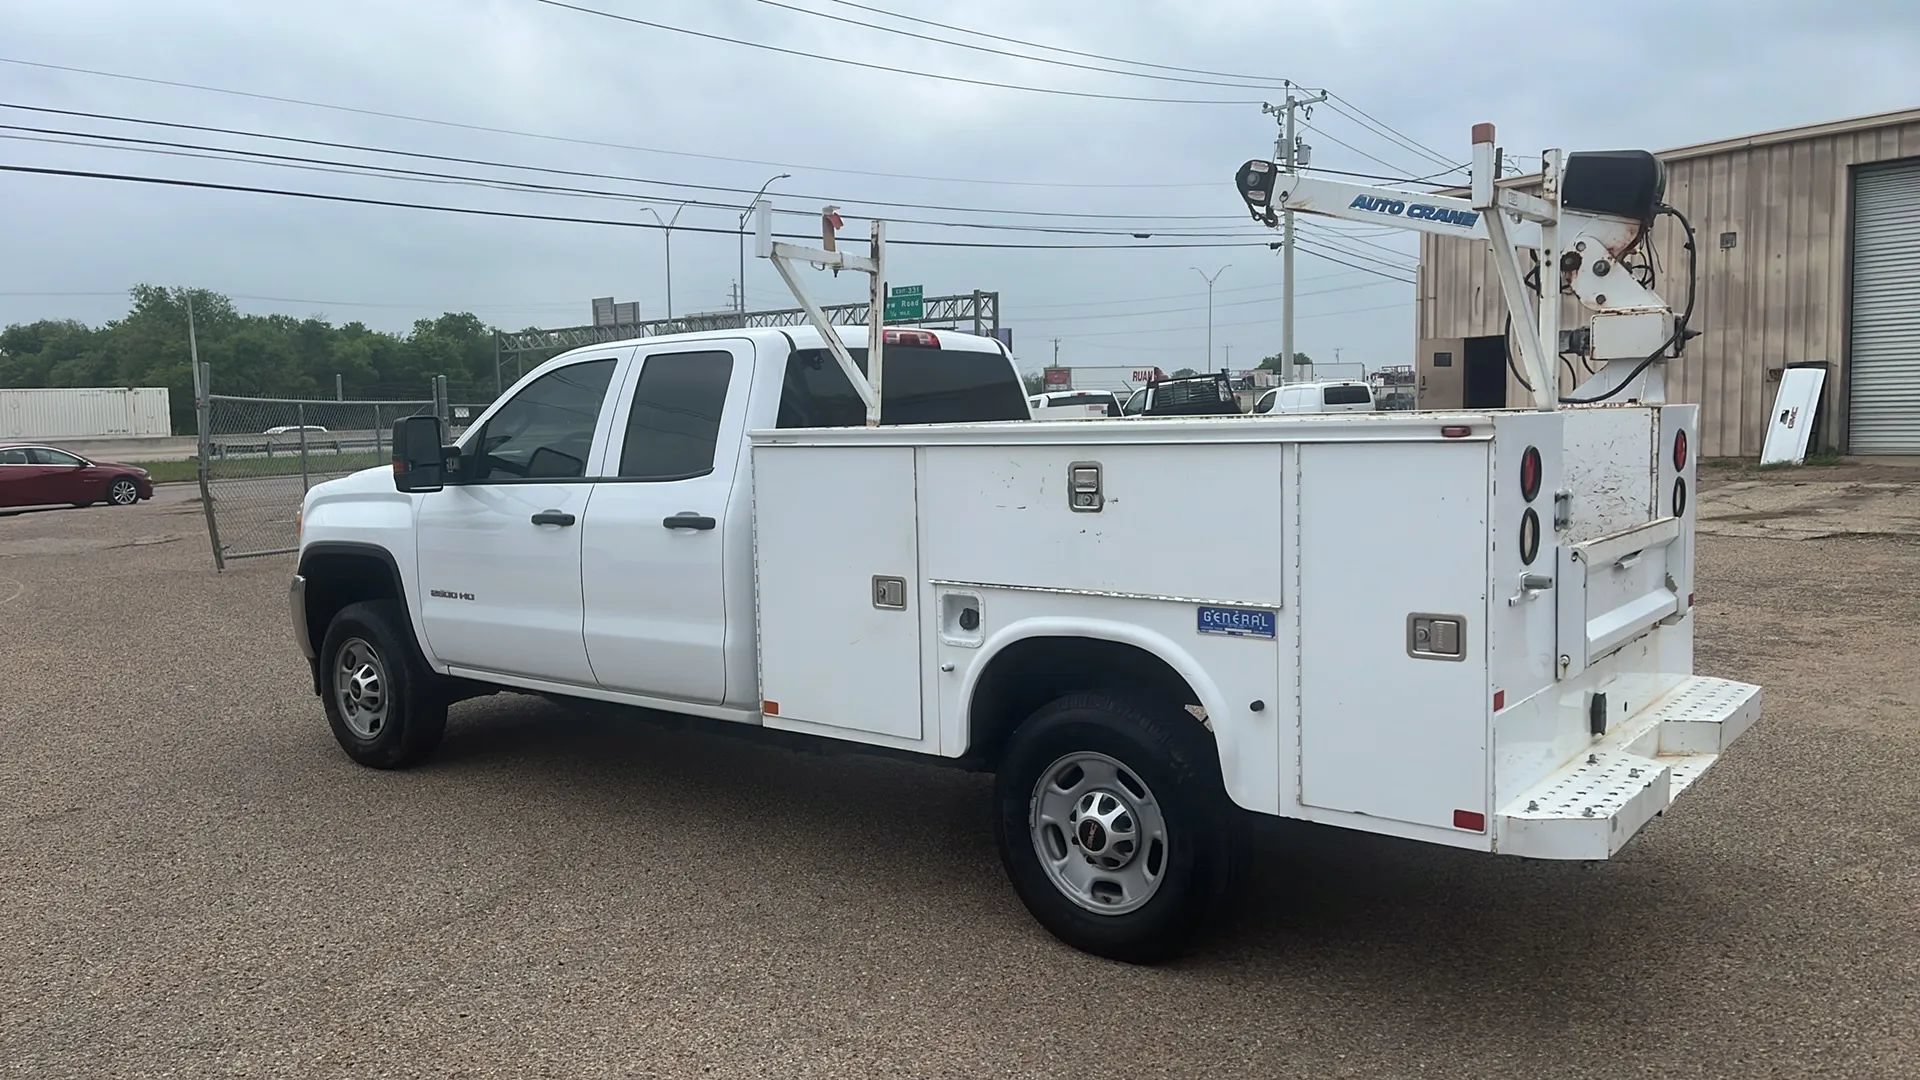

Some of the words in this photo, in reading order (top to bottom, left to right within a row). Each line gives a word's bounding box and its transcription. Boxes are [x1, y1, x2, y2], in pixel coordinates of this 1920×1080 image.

[1349, 194, 1405, 215] AUTO
[1407, 203, 1480, 228] CRANE
[1132, 370, 1153, 382] RUAN
[1788, 406, 1799, 429] GMC
[430, 589, 458, 599] 2500
[459, 592, 475, 601] HD
[1203, 611, 1269, 627] GENERAL
